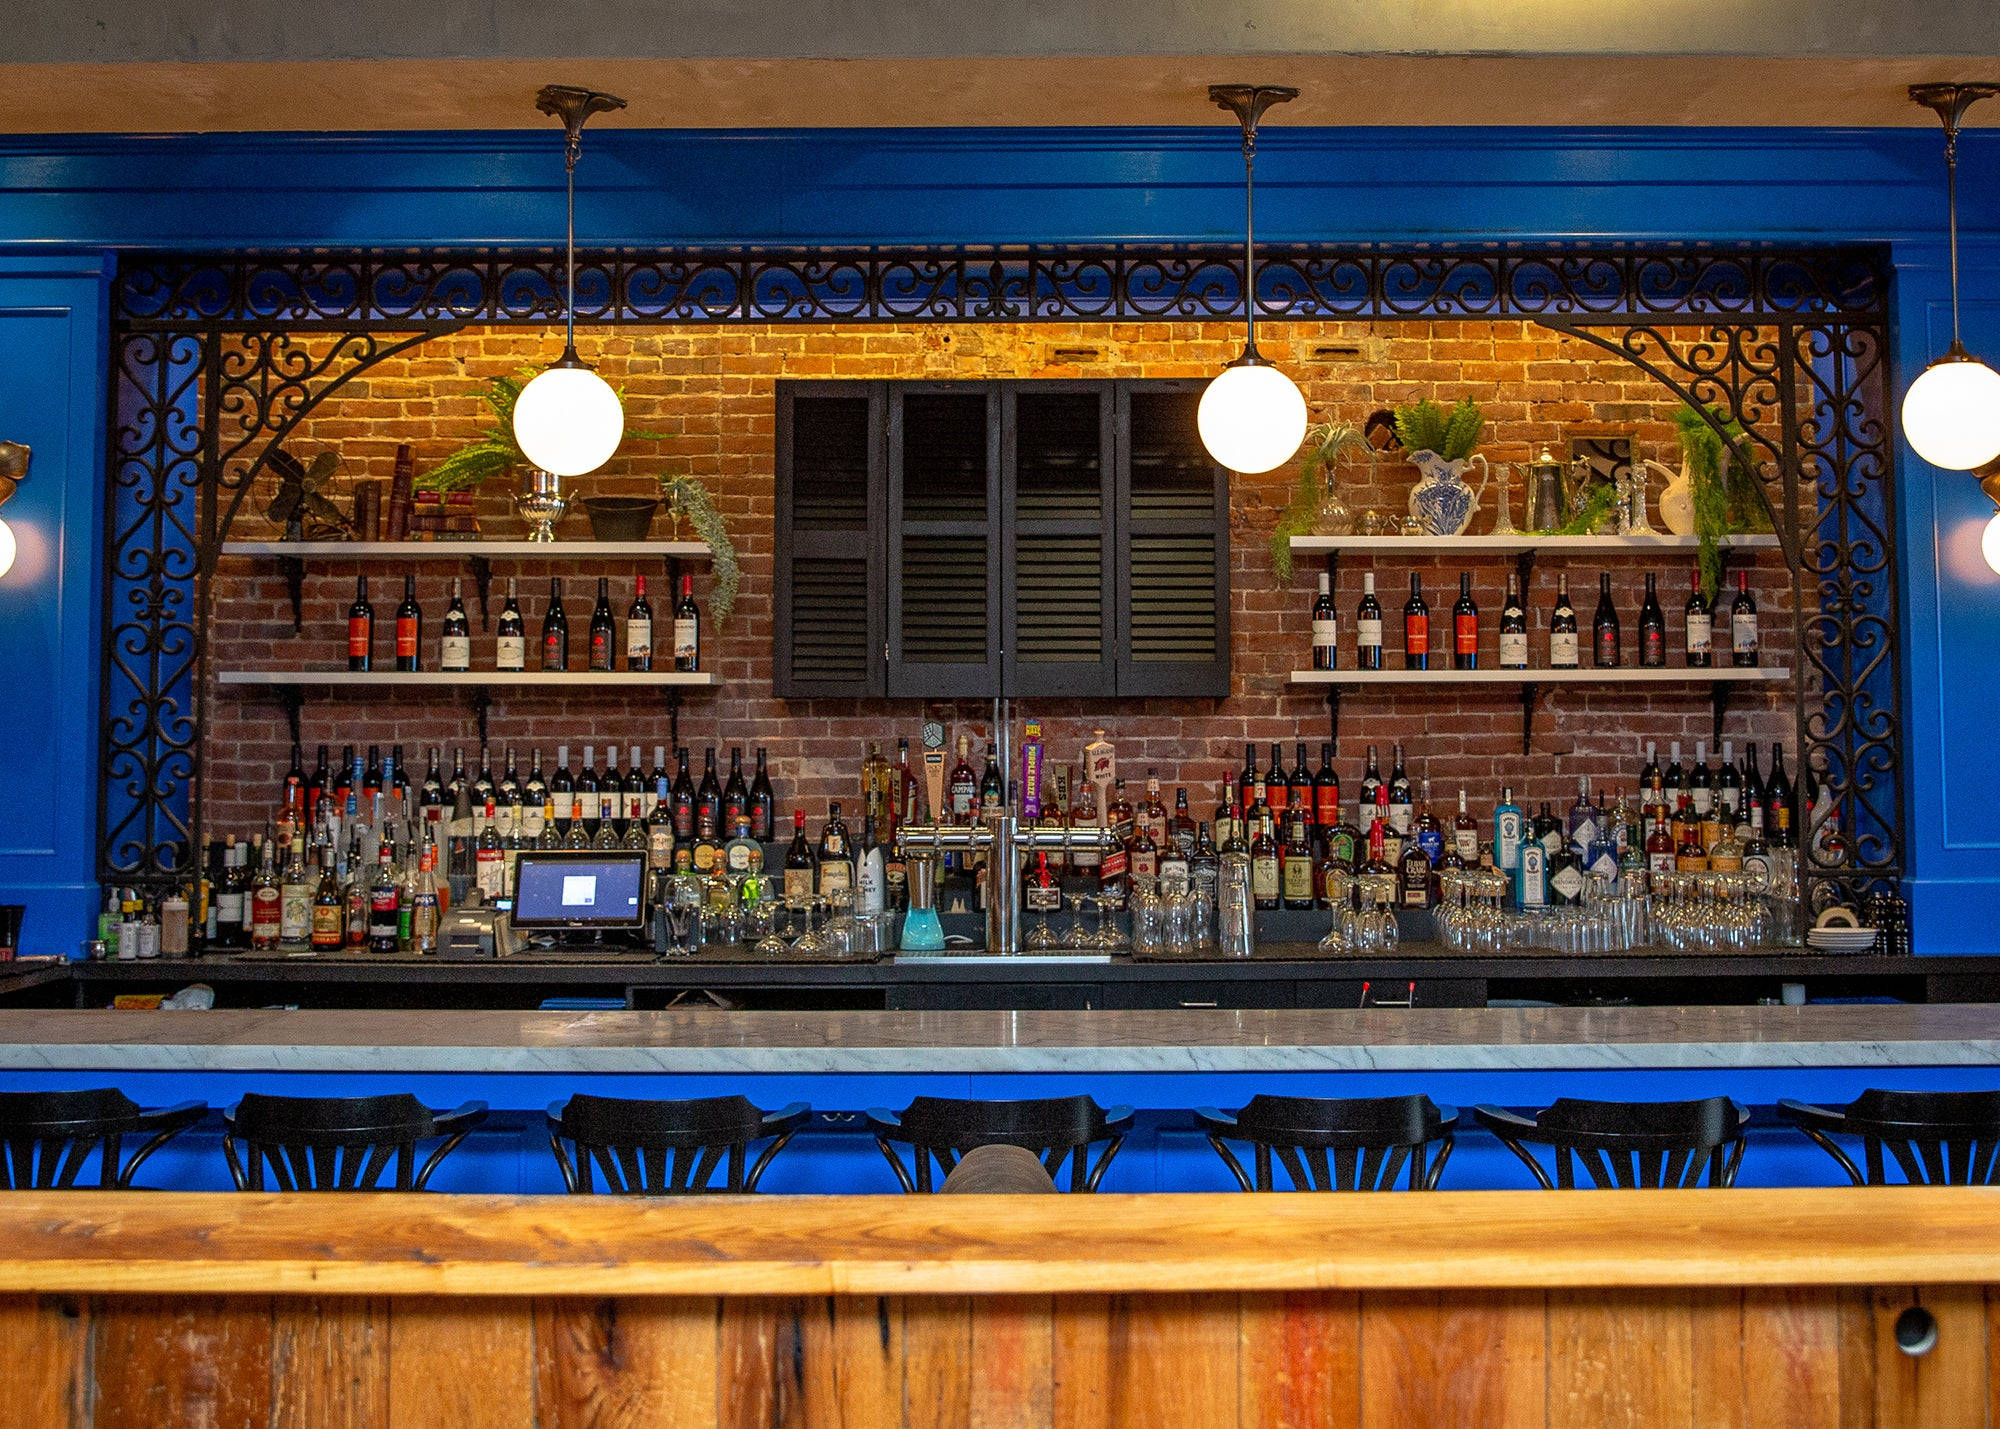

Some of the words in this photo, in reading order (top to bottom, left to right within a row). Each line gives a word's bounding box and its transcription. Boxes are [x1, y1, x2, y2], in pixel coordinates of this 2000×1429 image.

[1028, 746, 1036, 775] PURPLE
[1027, 775, 1035, 796] HAZE
[1058, 775, 1067, 801] KBS
[1257, 787, 1263, 797] 7
